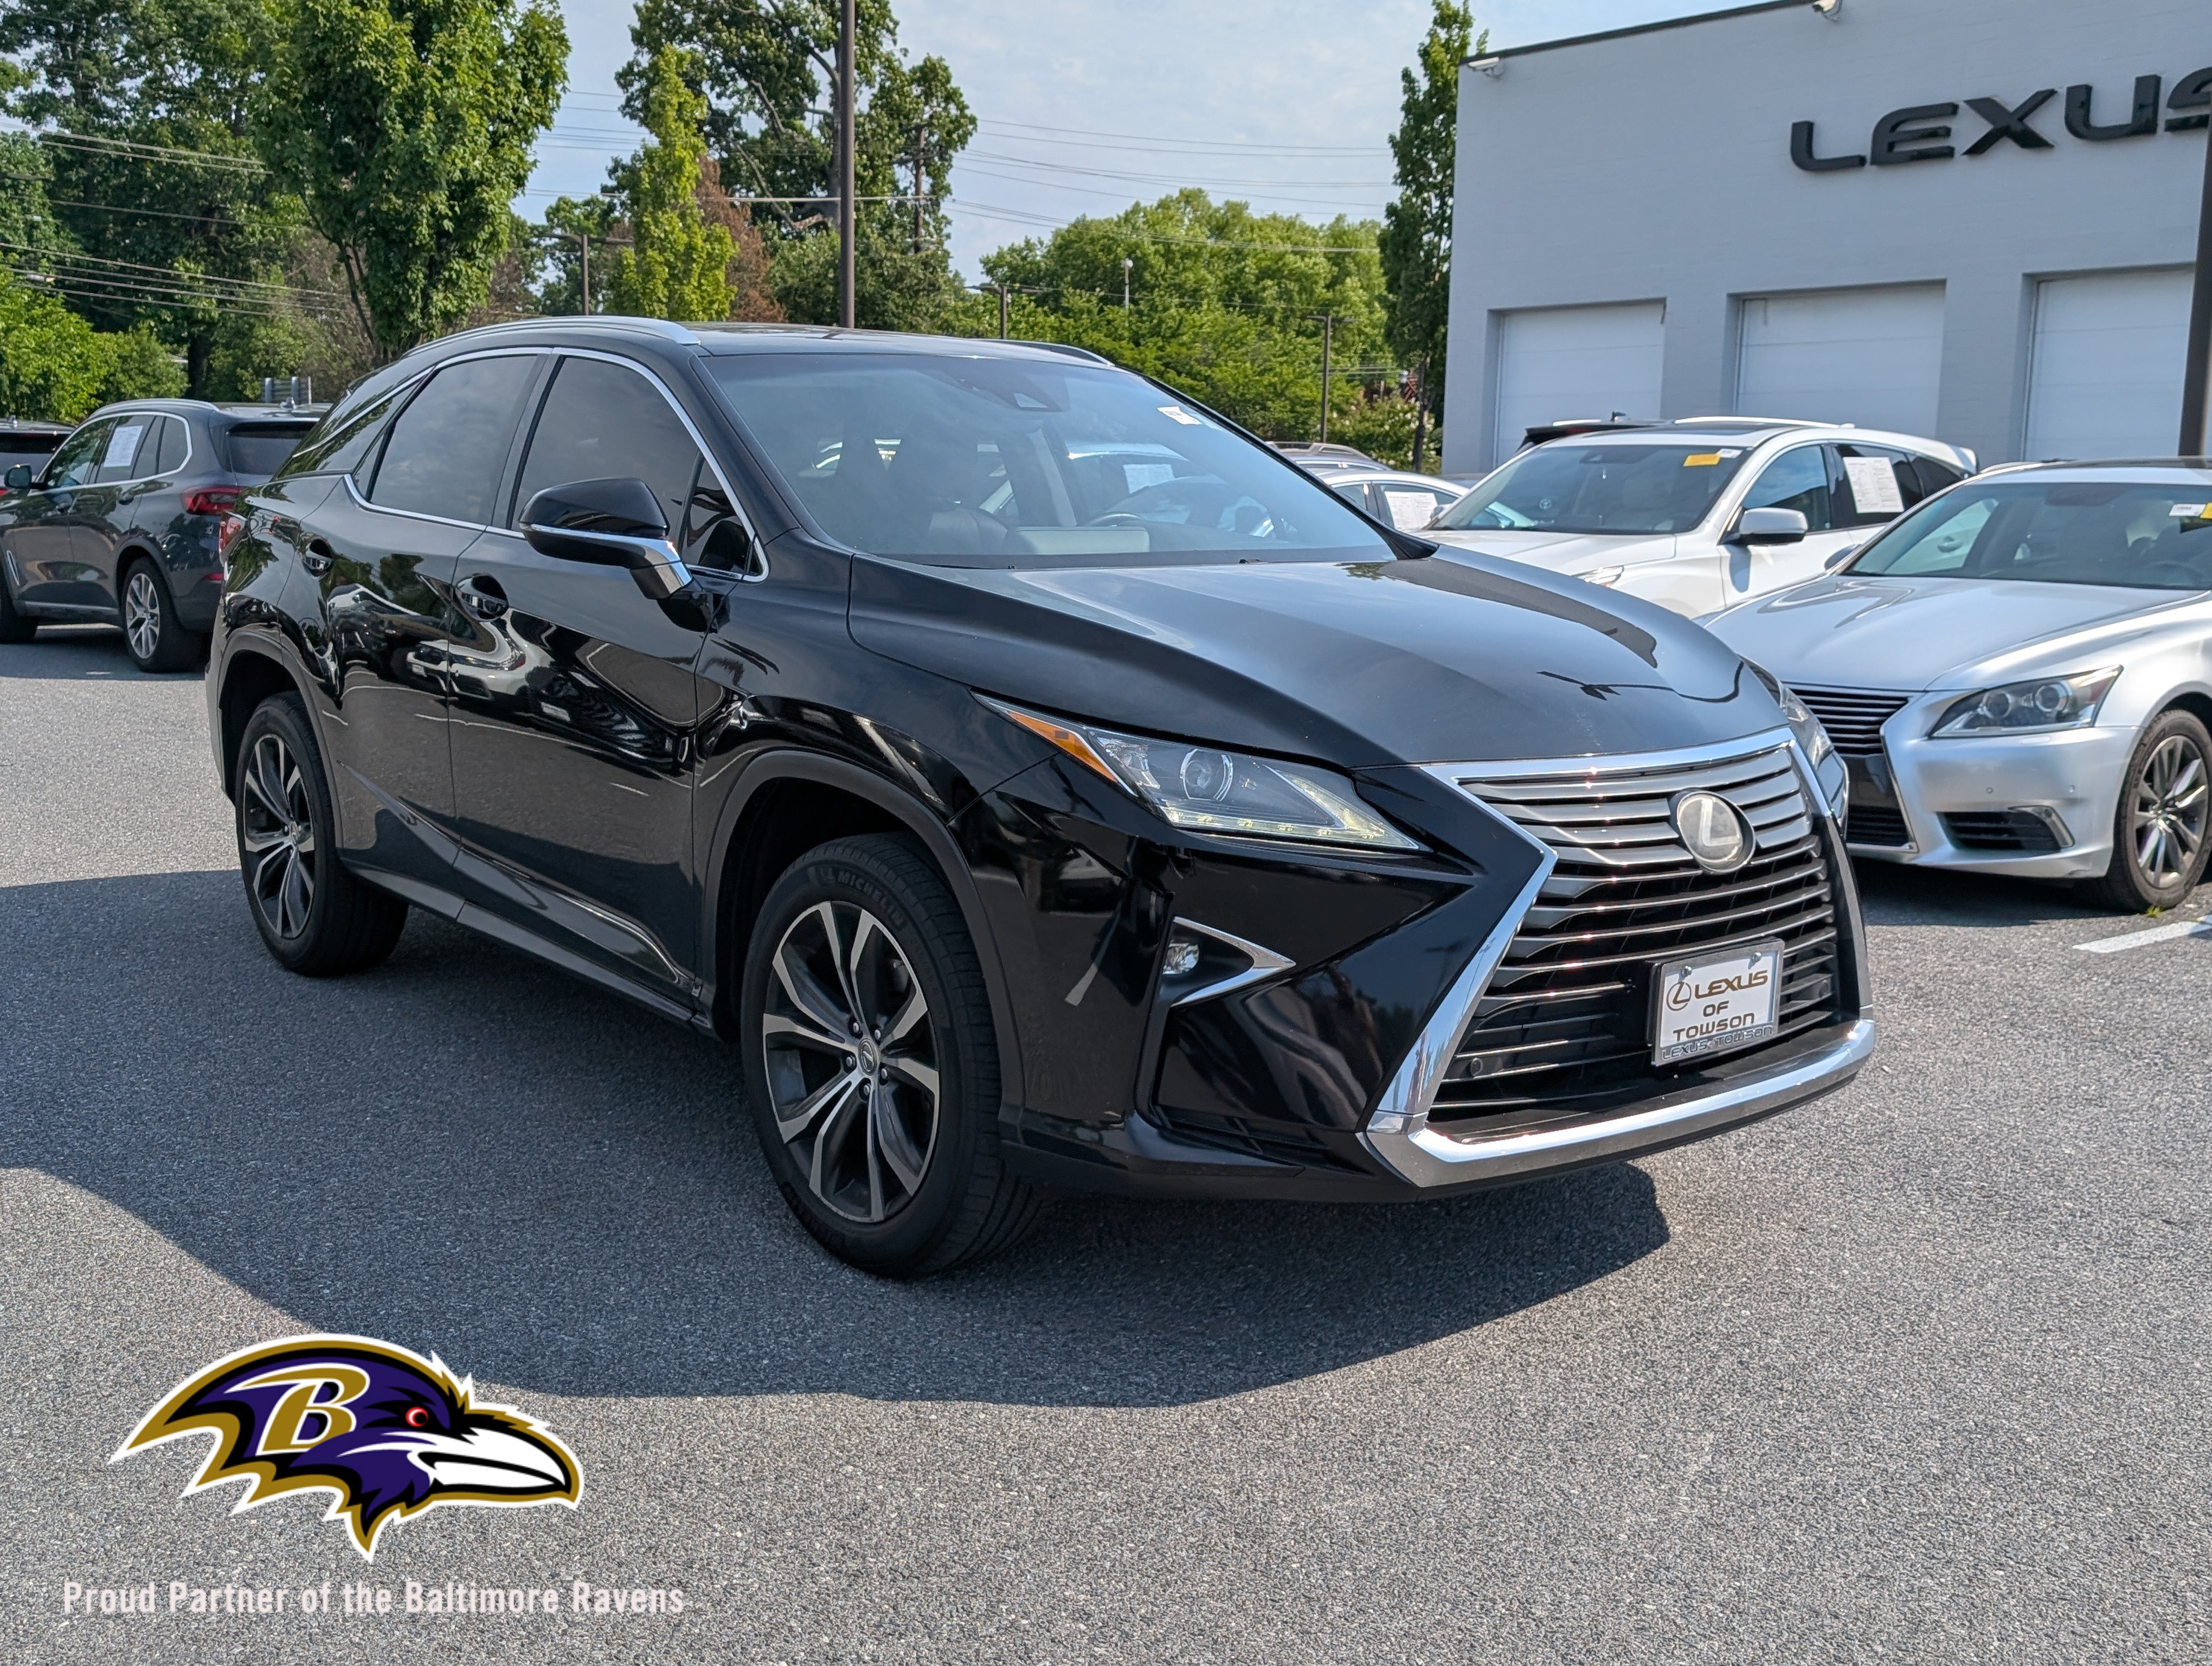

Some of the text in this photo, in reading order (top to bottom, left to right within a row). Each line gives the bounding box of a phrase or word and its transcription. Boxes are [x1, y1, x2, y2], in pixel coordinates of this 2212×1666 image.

[1694, 970, 1768, 999] LEXUS
[1702, 1001, 1729, 1017] OF
[1673, 1013, 1755, 1042] TOWSON
[1662, 1040, 1707, 1060] LEXUS
[1717, 1025, 1773, 1046] TOWSON
